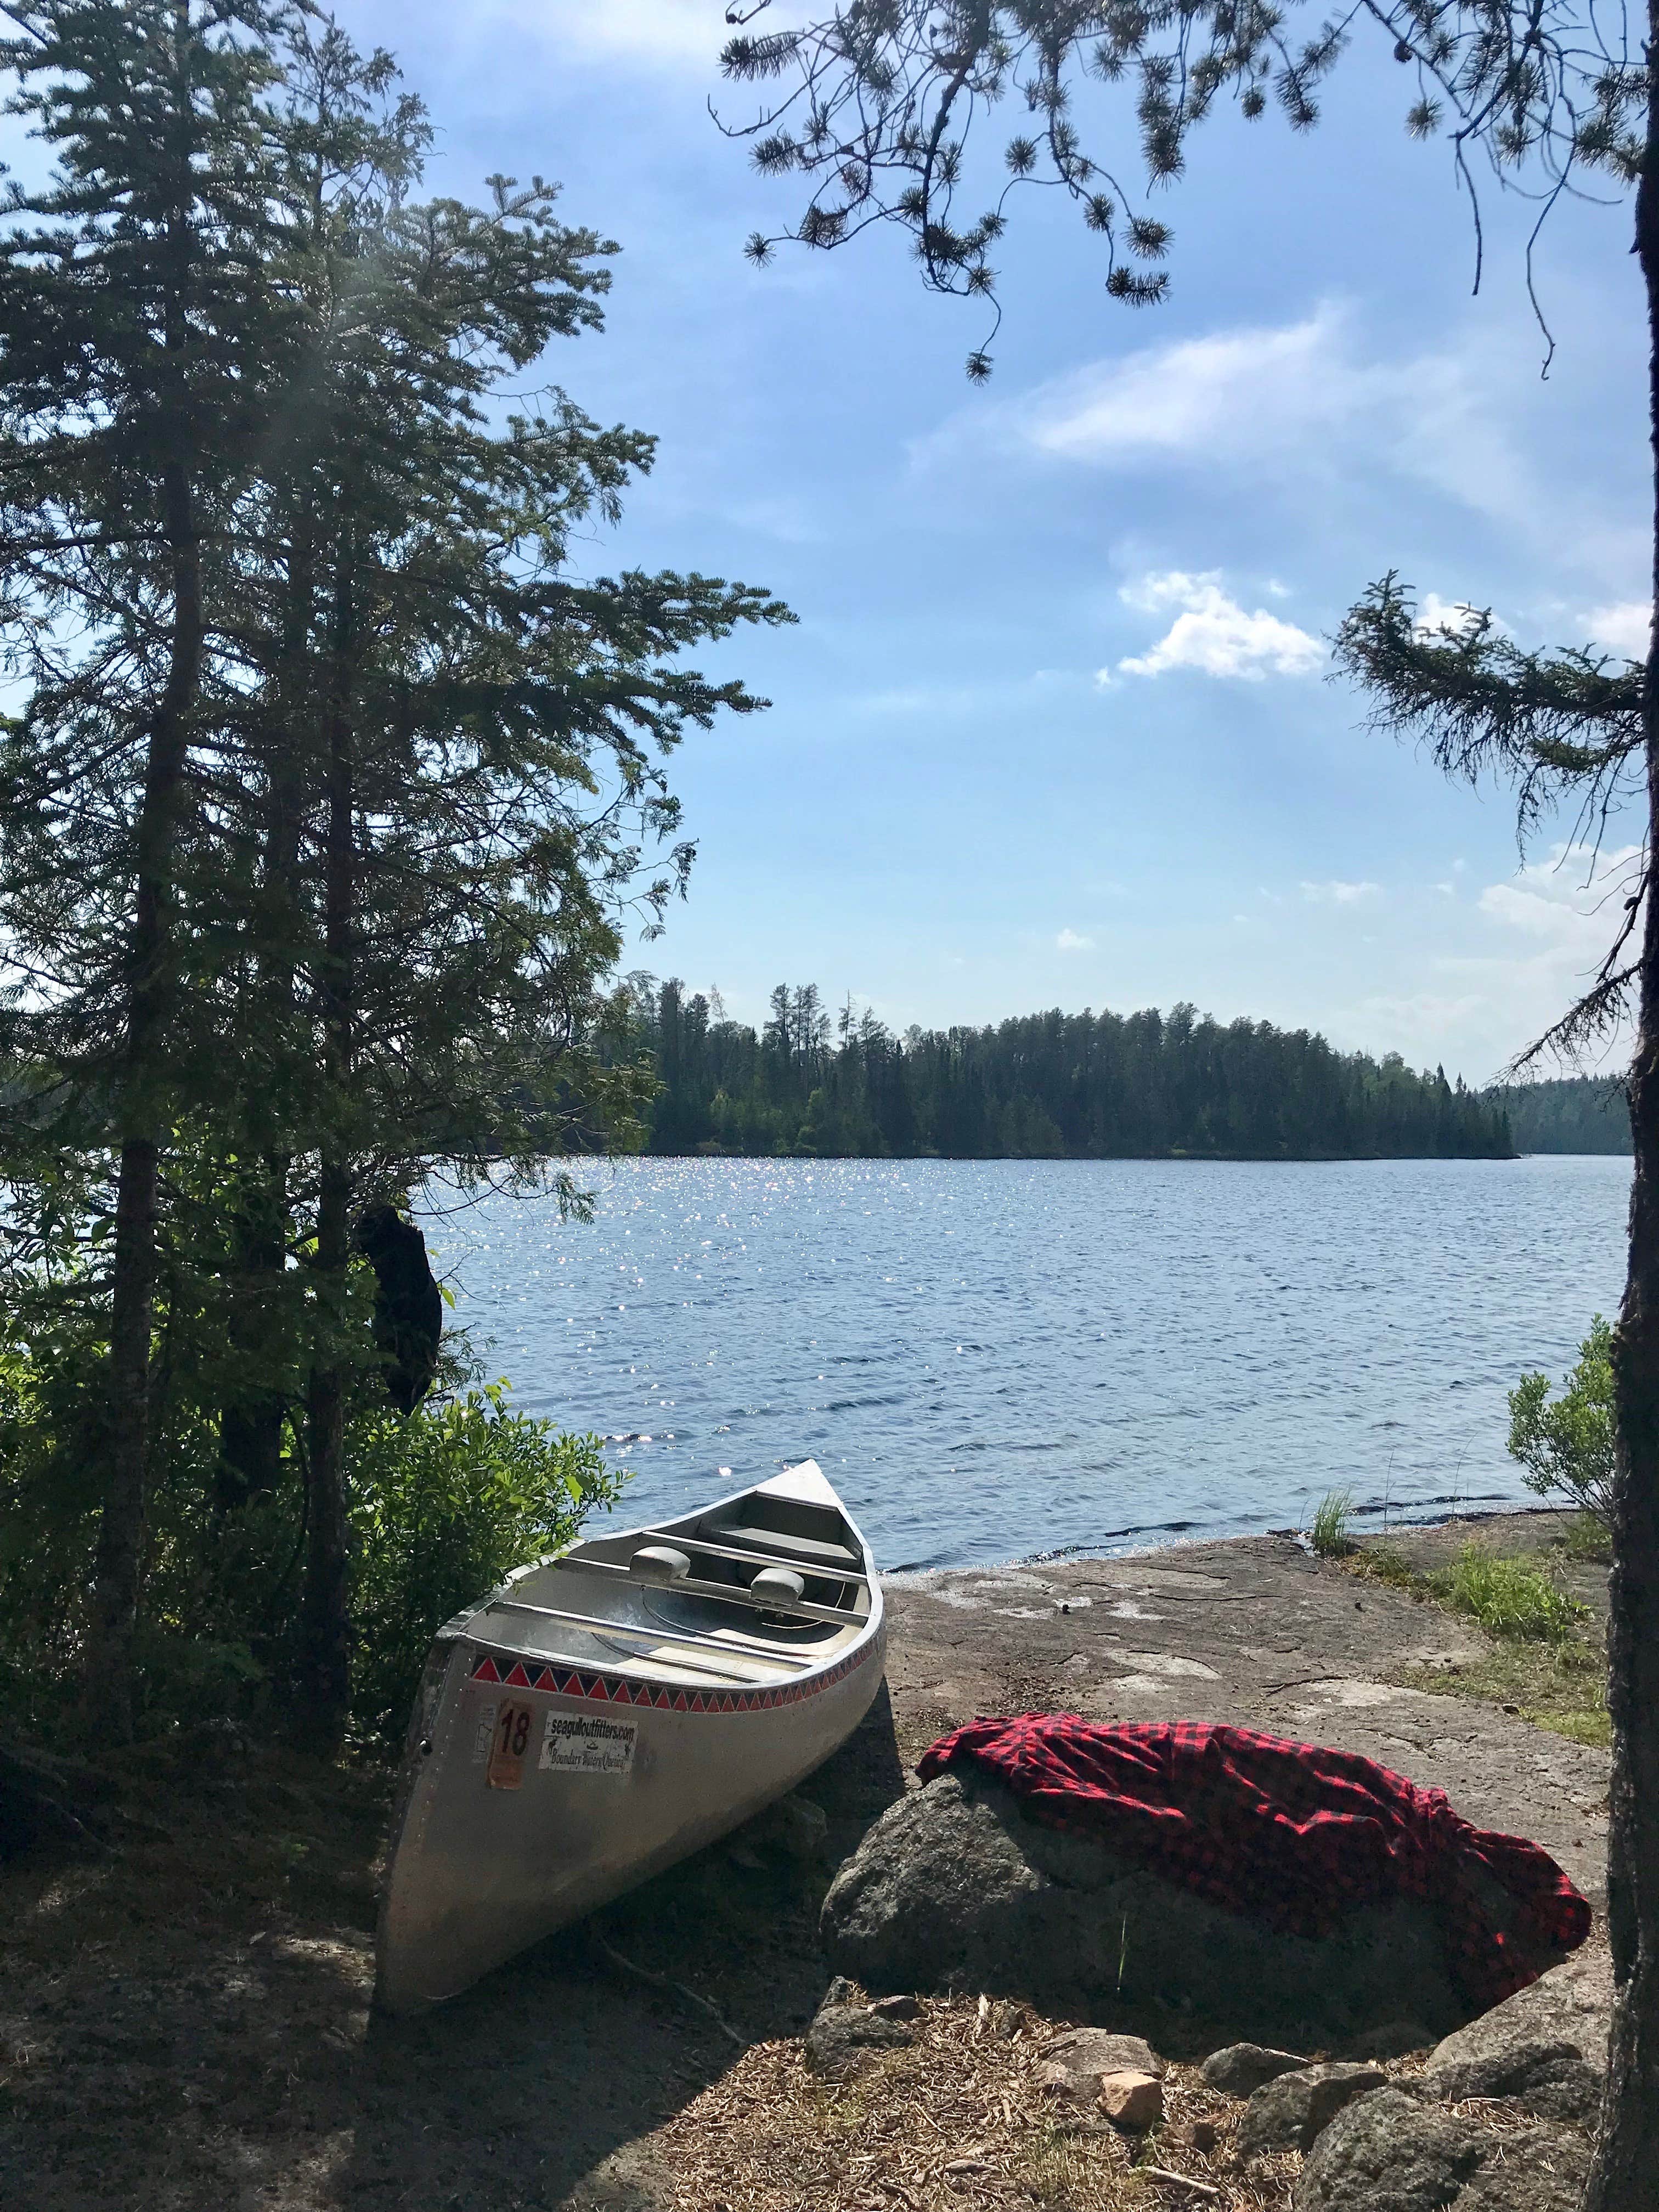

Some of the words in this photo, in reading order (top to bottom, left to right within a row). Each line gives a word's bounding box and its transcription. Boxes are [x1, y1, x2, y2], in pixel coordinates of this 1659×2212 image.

[500, 1709, 530, 1756] 18
[551, 1716, 635, 1742] seagulloutfitters.com
[552, 1748, 582, 1769] Boundary
